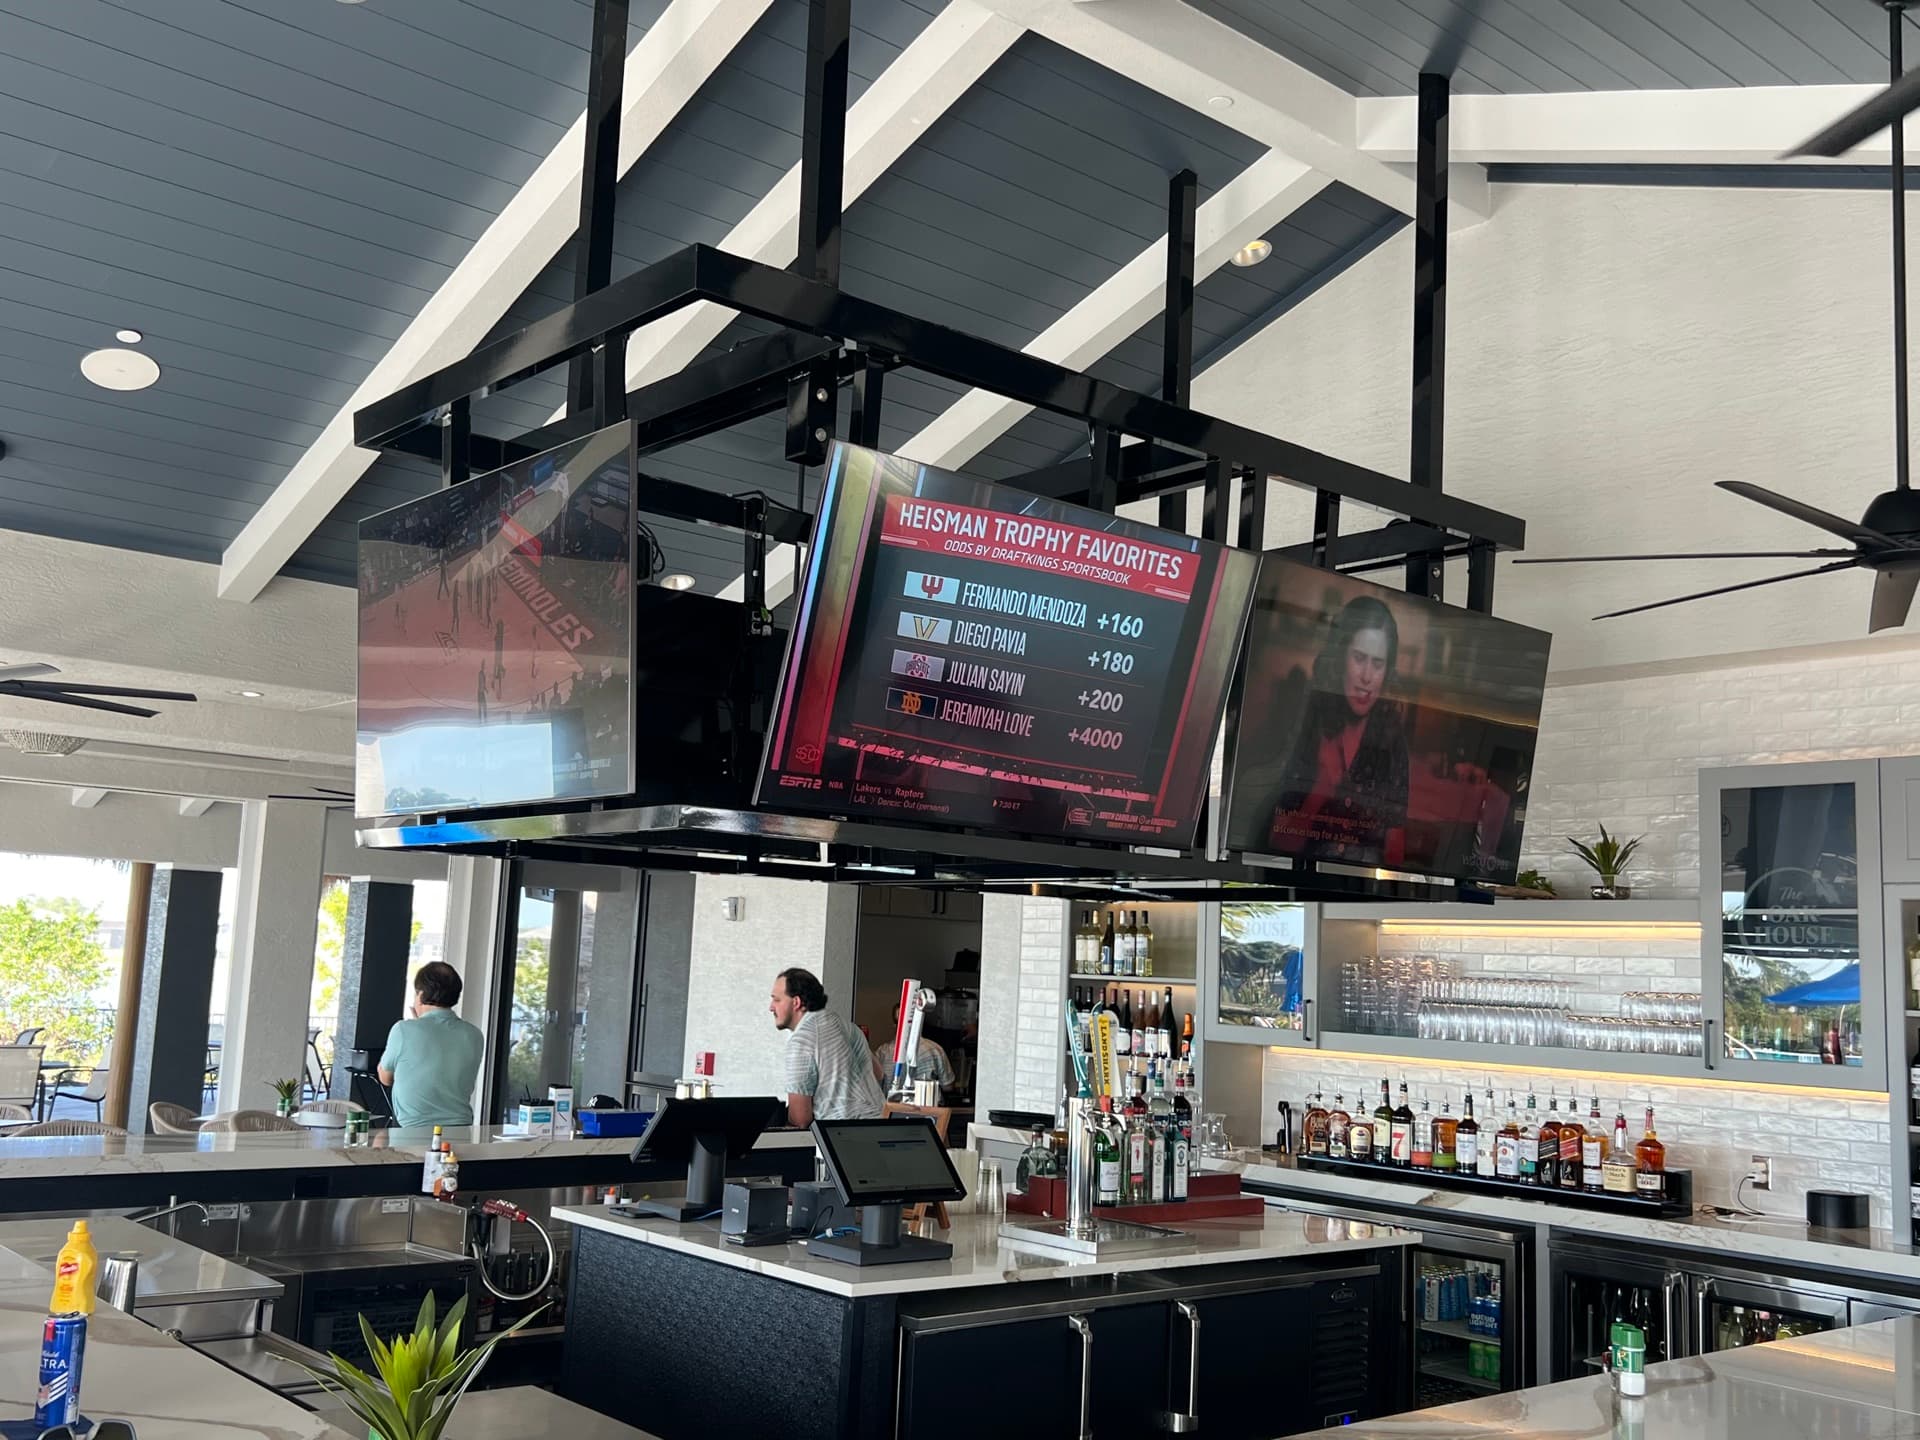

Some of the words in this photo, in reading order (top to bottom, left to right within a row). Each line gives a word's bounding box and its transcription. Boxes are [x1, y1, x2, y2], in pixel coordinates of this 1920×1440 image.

[899, 503, 988, 539] HEISMAN
[994, 518, 1075, 551] TROPHY
[1075, 534, 1183, 580] FAVORITES
[943, 539, 974, 555] ODDS
[975, 544, 991, 558] BY
[990, 547, 1060, 570] DRAFTKINGS
[1060, 560, 1133, 586] SPORTSBOOK
[961, 582, 1028, 616] FERNANDO
[1026, 595, 1088, 628] MENDOZA
[1096, 612, 1144, 639] +160
[954, 620, 992, 650] DIEGO
[991, 627, 1027, 656] PAVIA
[1087, 651, 1134, 675] +180
[946, 661, 992, 690] JULIAN
[988, 667, 1026, 697] SAYIN
[1078, 689, 1124, 713] +200
[940, 699, 1003, 732] JEREMIYAH
[1003, 711, 1036, 737] LOVE
[1068, 727, 1123, 750] +4000
[855, 783, 882, 795] Lakers
[894, 787, 925, 800] Raptors
[1754, 926, 1834, 944] HOUSE
[1769, 904, 1819, 923] OAK
[1100, 1025, 1111, 1086] LANDSHARK
[1392, 1132, 1406, 1157] 7
